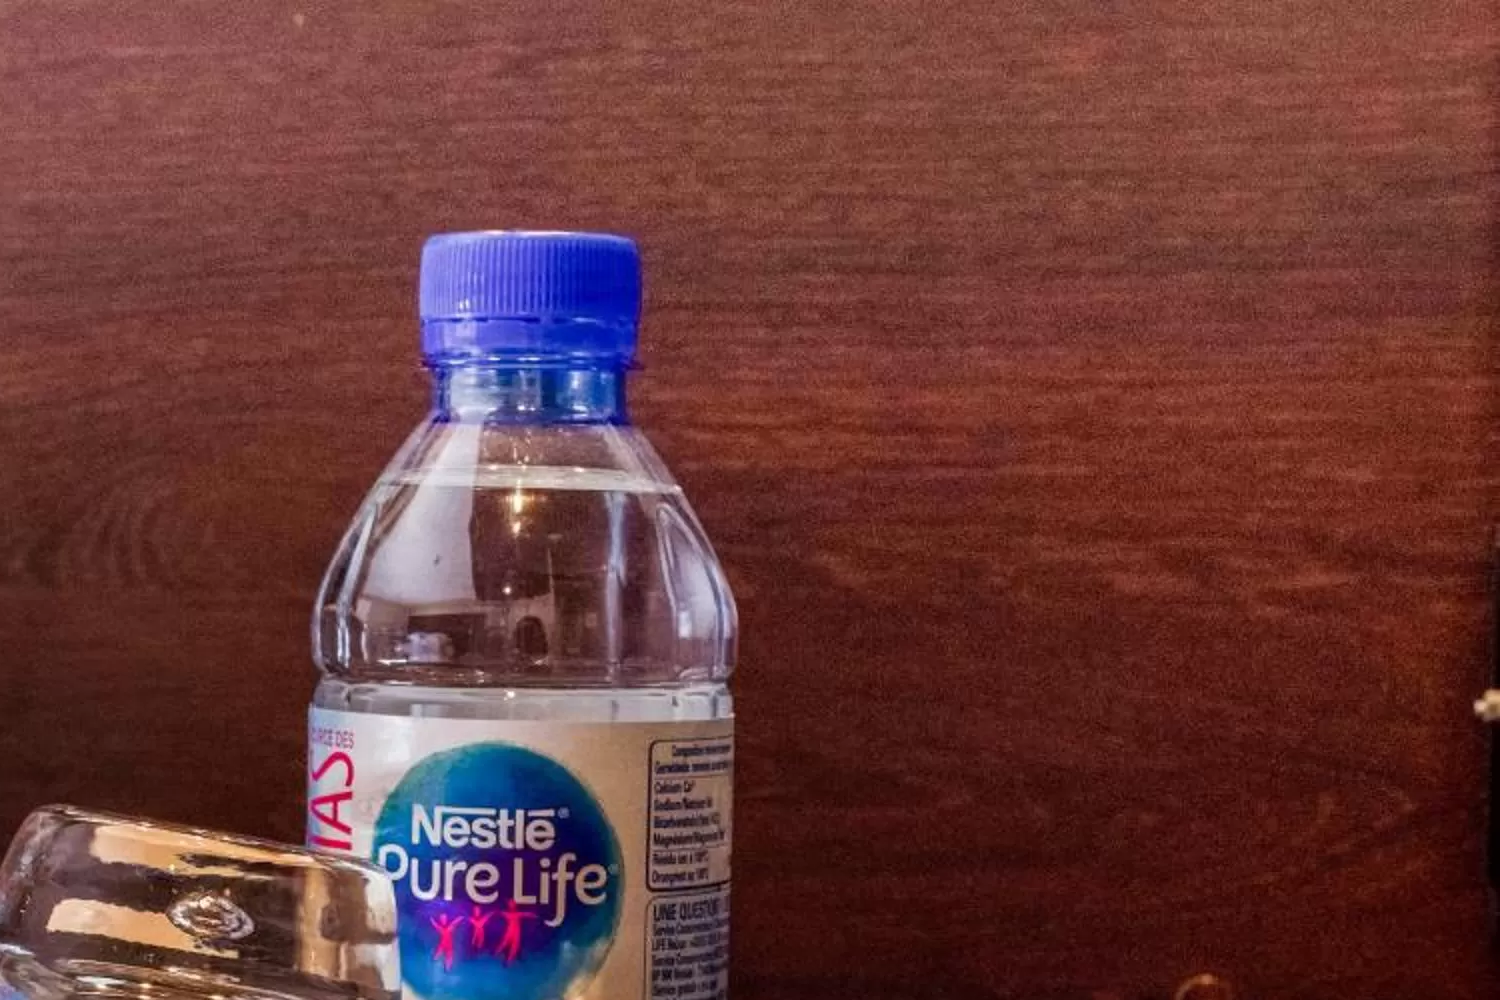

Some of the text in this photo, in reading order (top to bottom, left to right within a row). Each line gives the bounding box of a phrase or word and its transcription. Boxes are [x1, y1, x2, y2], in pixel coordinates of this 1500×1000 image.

[411, 804, 556, 851] Nestlé
[378, 843, 607, 928] Pure Life
